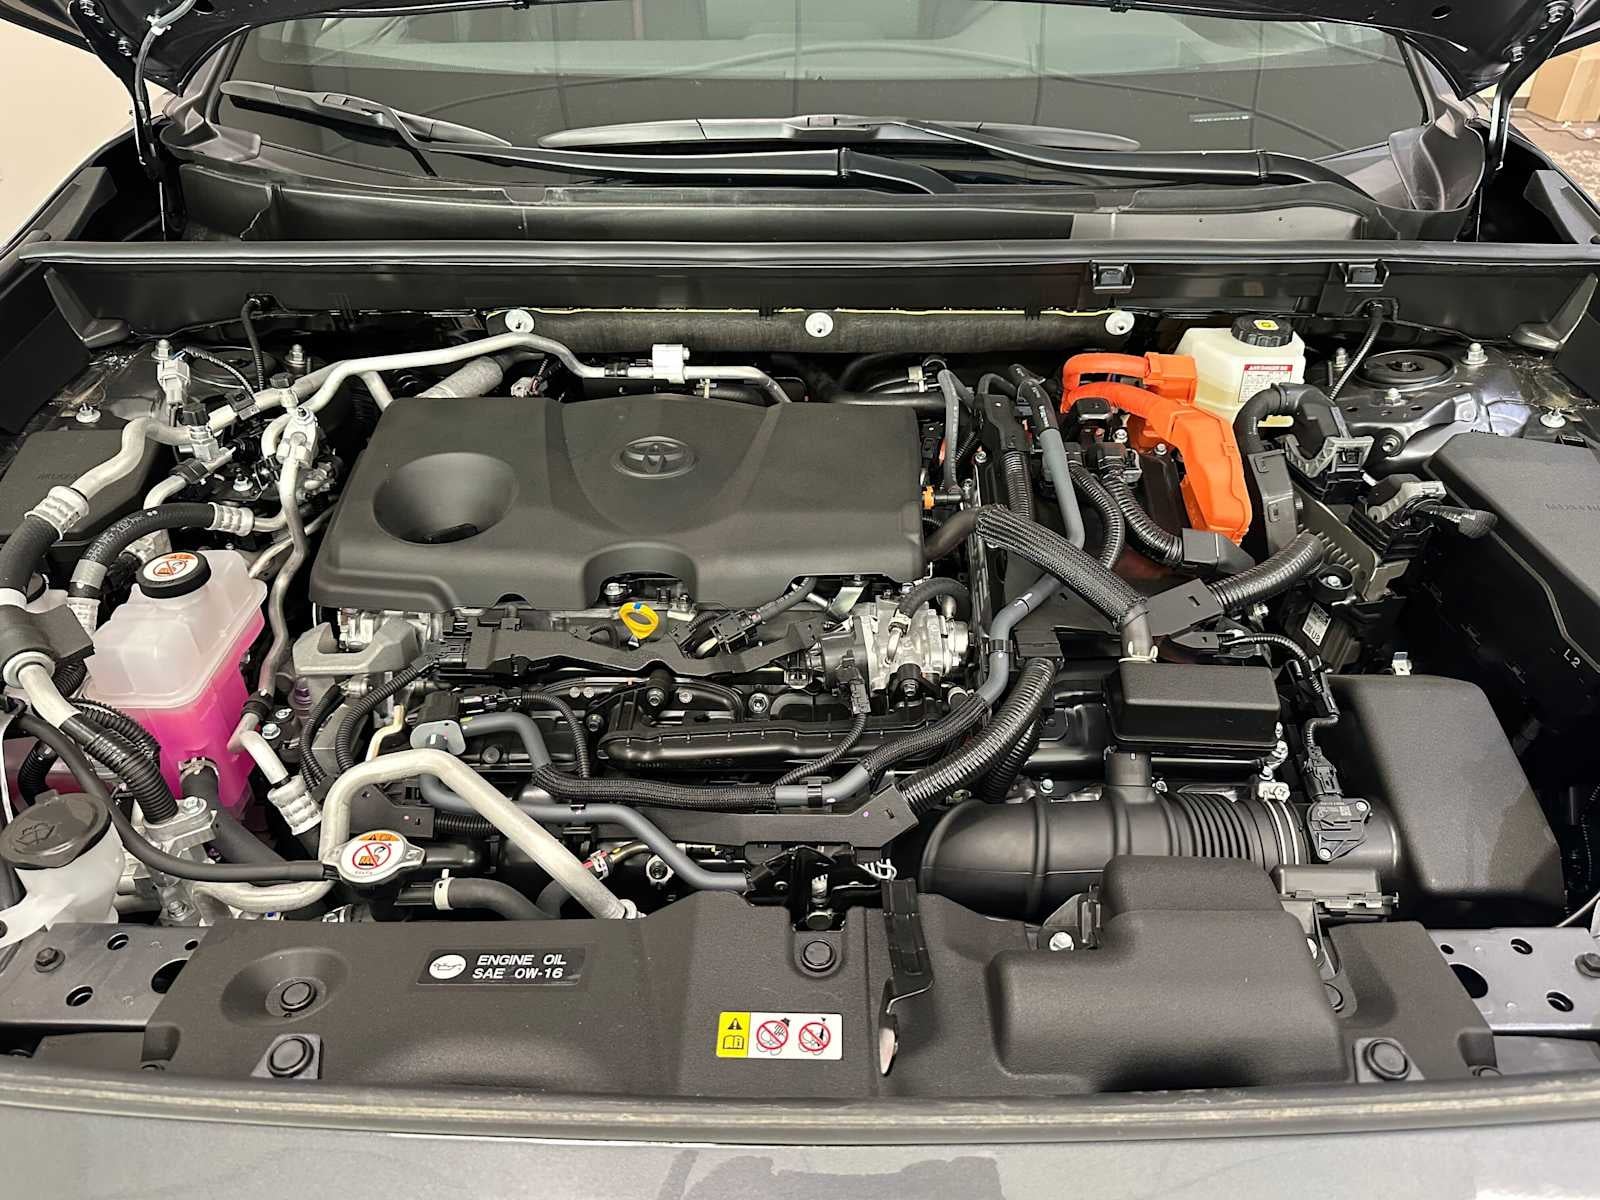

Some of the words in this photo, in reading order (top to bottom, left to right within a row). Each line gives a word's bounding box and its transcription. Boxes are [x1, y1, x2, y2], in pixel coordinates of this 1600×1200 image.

[1563, 648, 1581, 668] L2
[477, 954, 535, 965] ENGINE
[543, 954, 567, 965] OIL
[472, 968, 505, 979] SAE
[514, 968, 564, 979] 0W-16
